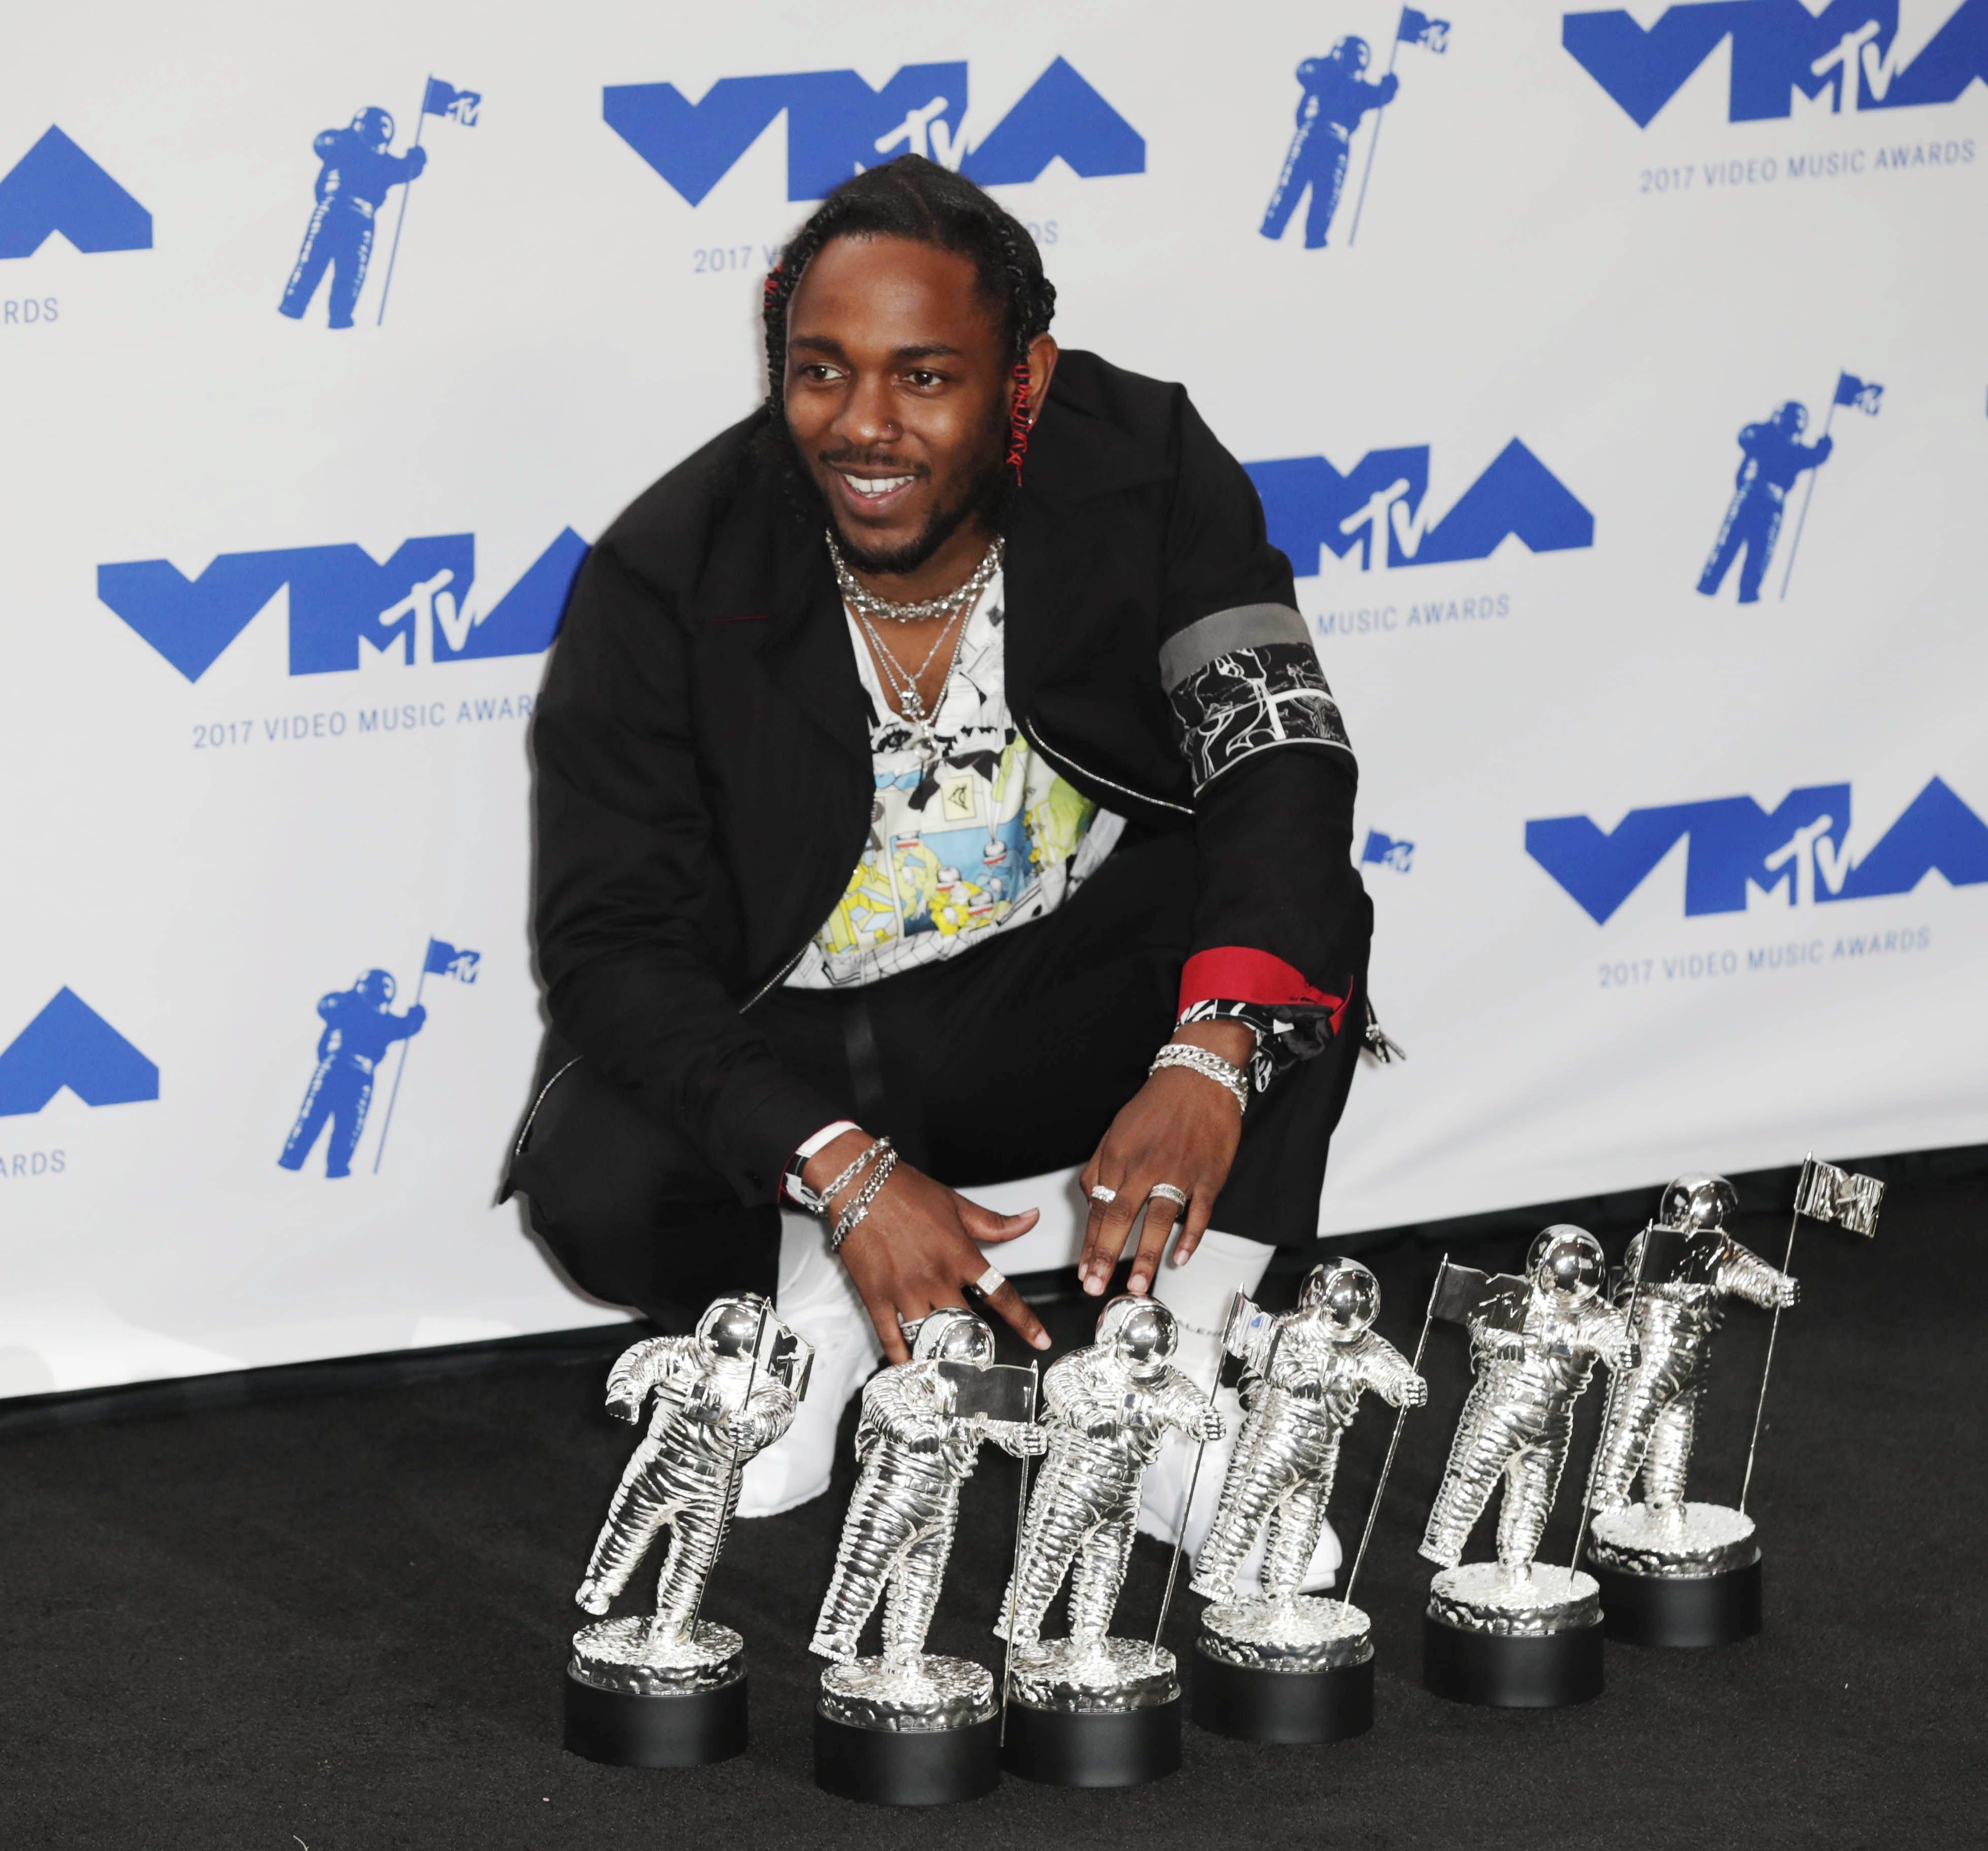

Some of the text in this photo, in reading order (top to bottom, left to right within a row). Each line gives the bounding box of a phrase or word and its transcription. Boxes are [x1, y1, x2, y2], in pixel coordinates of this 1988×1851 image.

[603, 54, 1146, 208] VMA
[1640, 138, 1976, 193] 2017 VIDEO MUSIC AWARDS
[694, 246, 753, 274] 2017
[4, 296, 59, 325] RDS
[1242, 436, 1595, 579] MA
[1316, 594, 1510, 636] MUSIC AWARDS
[193, 694, 533, 749] 2017 VIDEO MUSIC AWAR
[1524, 775, 1988, 926] VMA
[1598, 926, 1931, 988] 2017 VIDEO MUSIC AWARDS
[0, 1149, 65, 1178] ARDS
